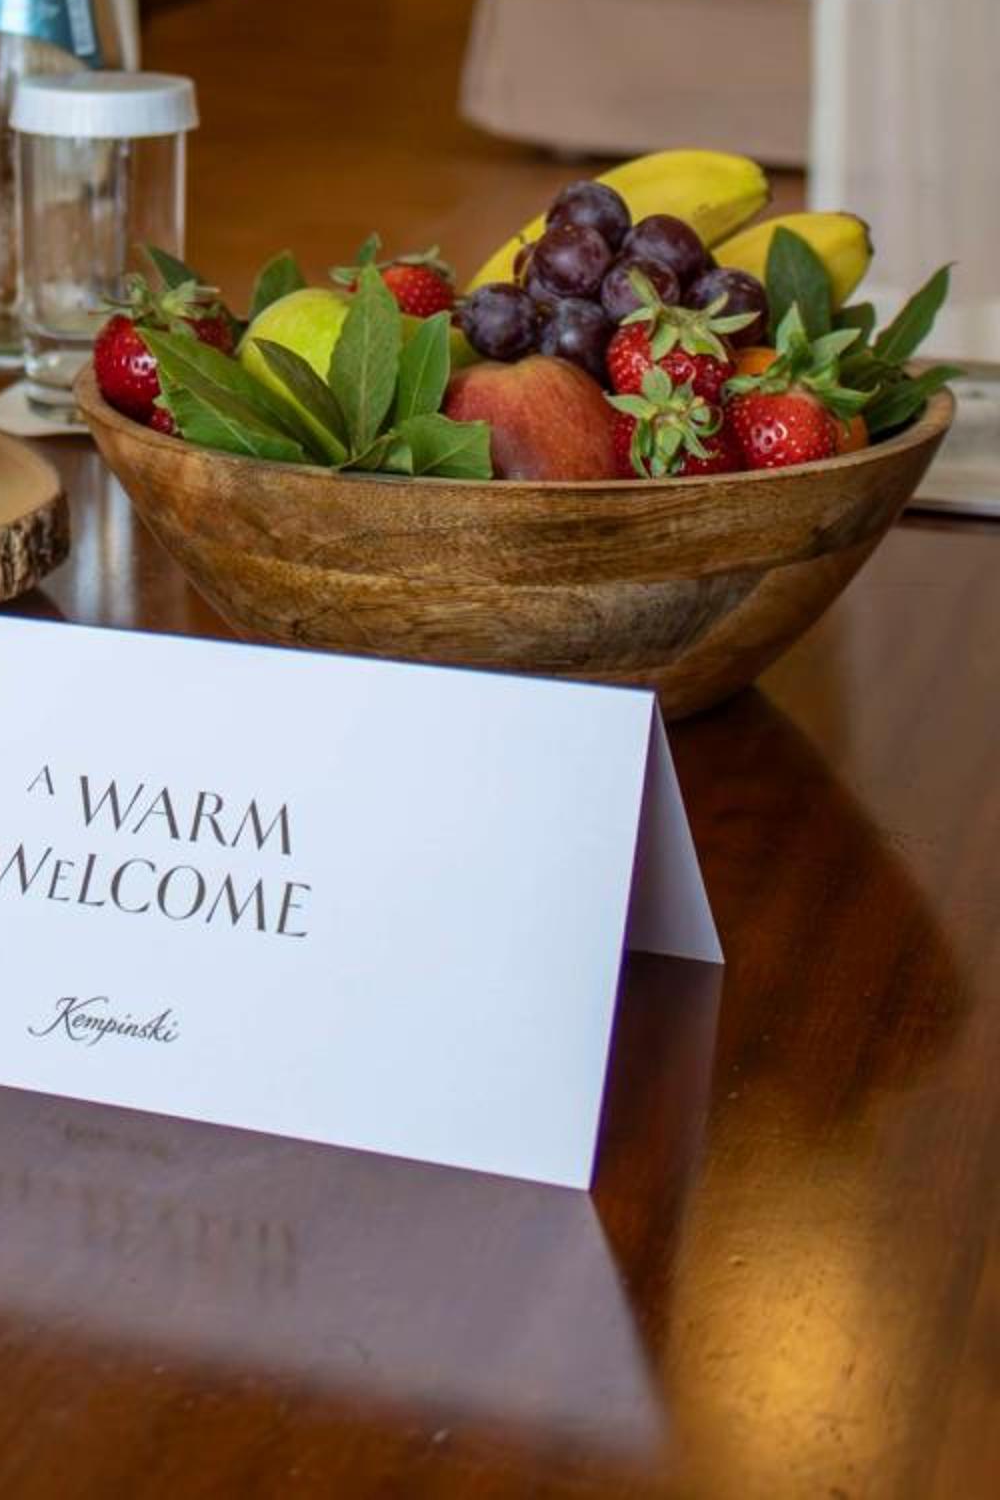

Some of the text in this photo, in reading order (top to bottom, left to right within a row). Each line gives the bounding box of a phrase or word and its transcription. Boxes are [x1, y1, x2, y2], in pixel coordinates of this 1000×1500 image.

[27, 764, 293, 856] A WARM
[27, 996, 180, 1048] Kempinski
